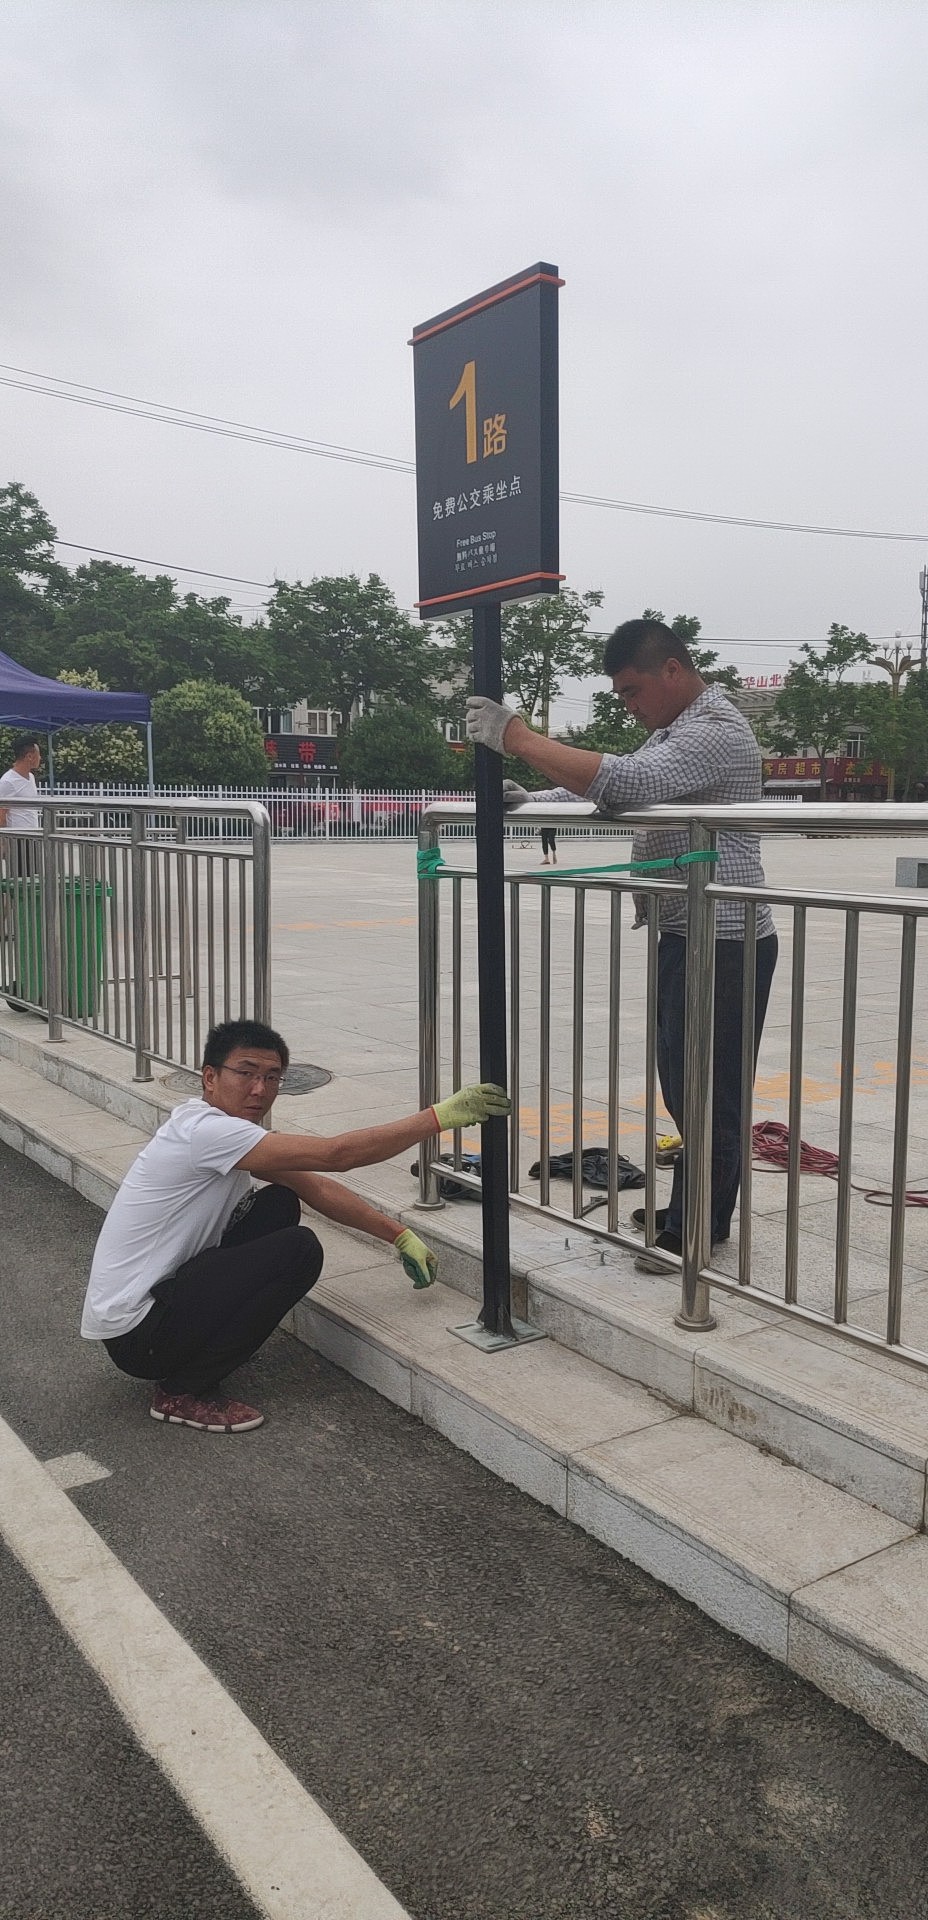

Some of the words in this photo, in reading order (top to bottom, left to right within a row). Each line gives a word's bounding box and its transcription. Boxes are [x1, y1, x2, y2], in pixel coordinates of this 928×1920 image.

[432, 475, 522, 521] 免费公交乘坐点
[456, 538, 470, 548] Free
[470, 535, 482, 544] Bus
[482, 530, 496, 540] Stop
